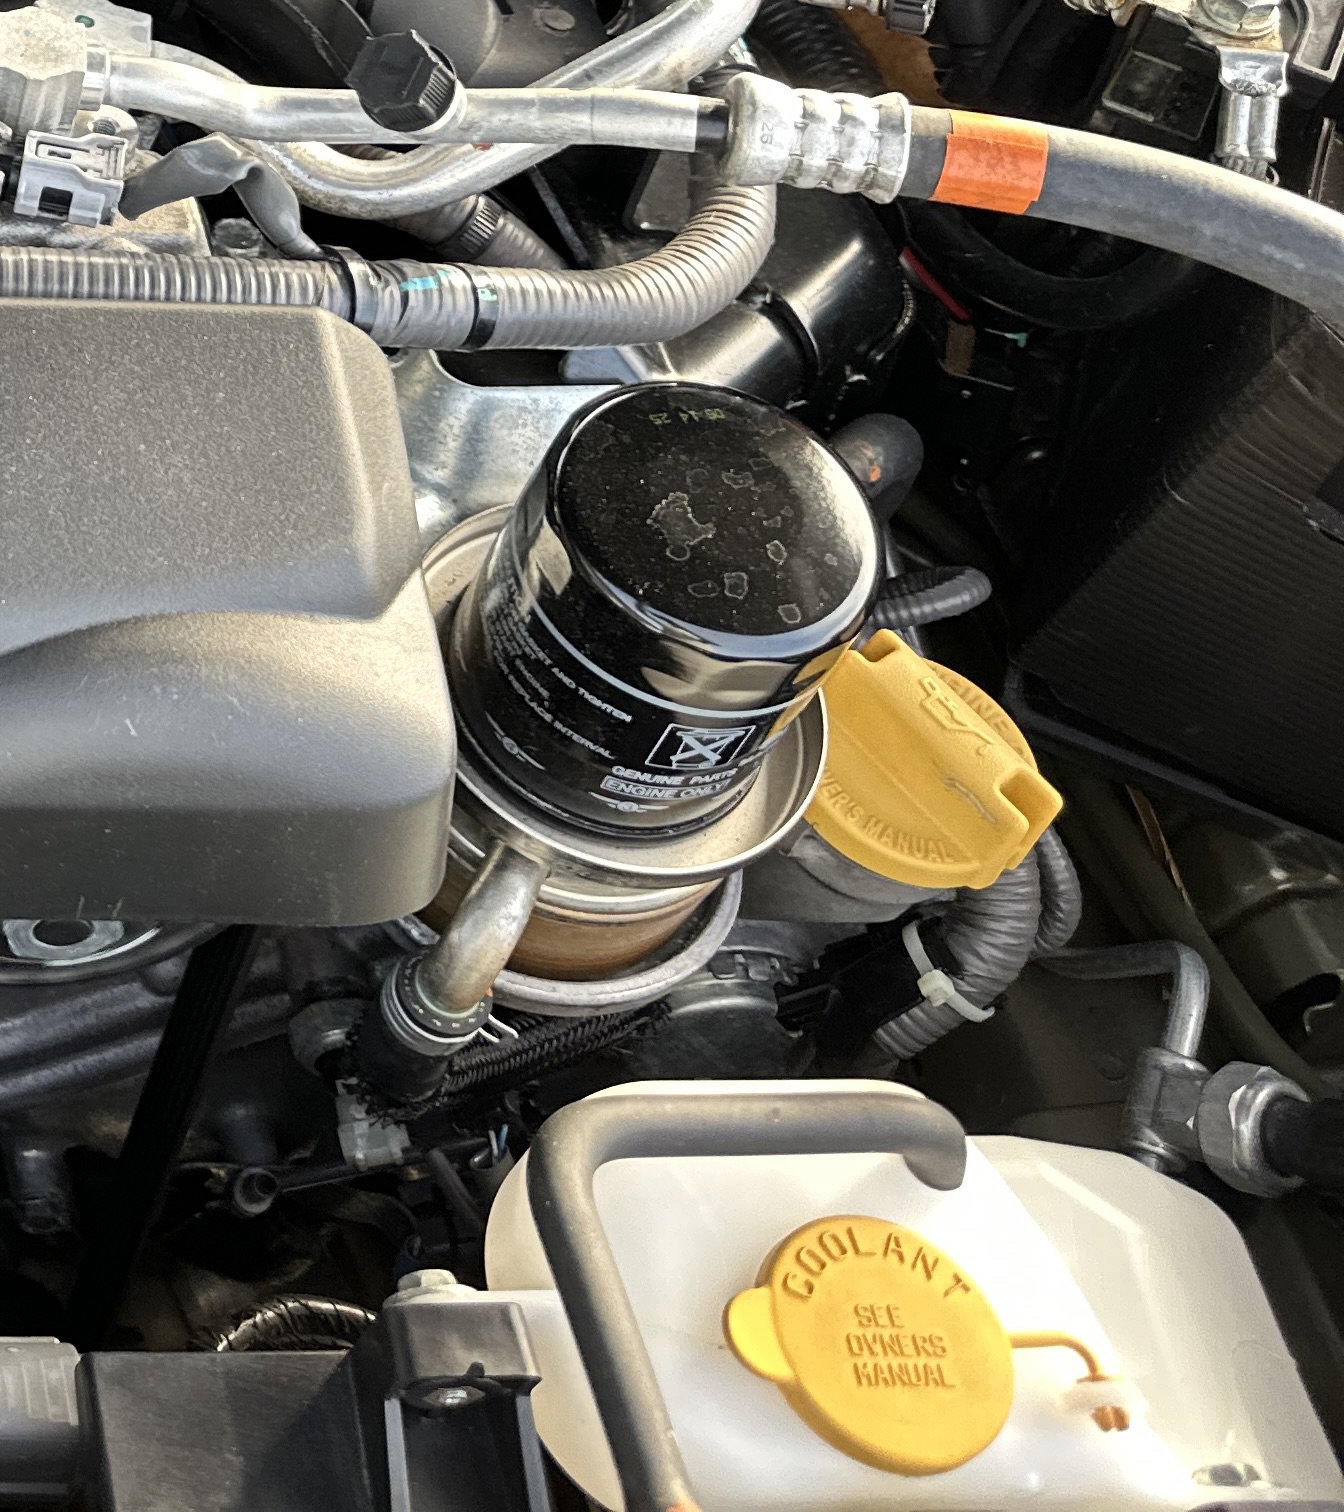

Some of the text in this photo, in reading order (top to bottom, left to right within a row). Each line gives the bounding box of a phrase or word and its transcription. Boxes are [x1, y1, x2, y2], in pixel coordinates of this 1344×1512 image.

[578, 687, 633, 723] TIGHTEN
[553, 721, 616, 760] INTERVAL
[603, 779, 678, 799] ENGINE
[611, 765, 739, 786] GENUINE PARTS
[862, 816, 956, 864] MANUAL
[781, 1226, 972, 1302] COOLANT
[853, 1303, 905, 1329] SEE
[845, 1331, 948, 1359] OWNERS
[852, 1361, 957, 1389] MANUAL
